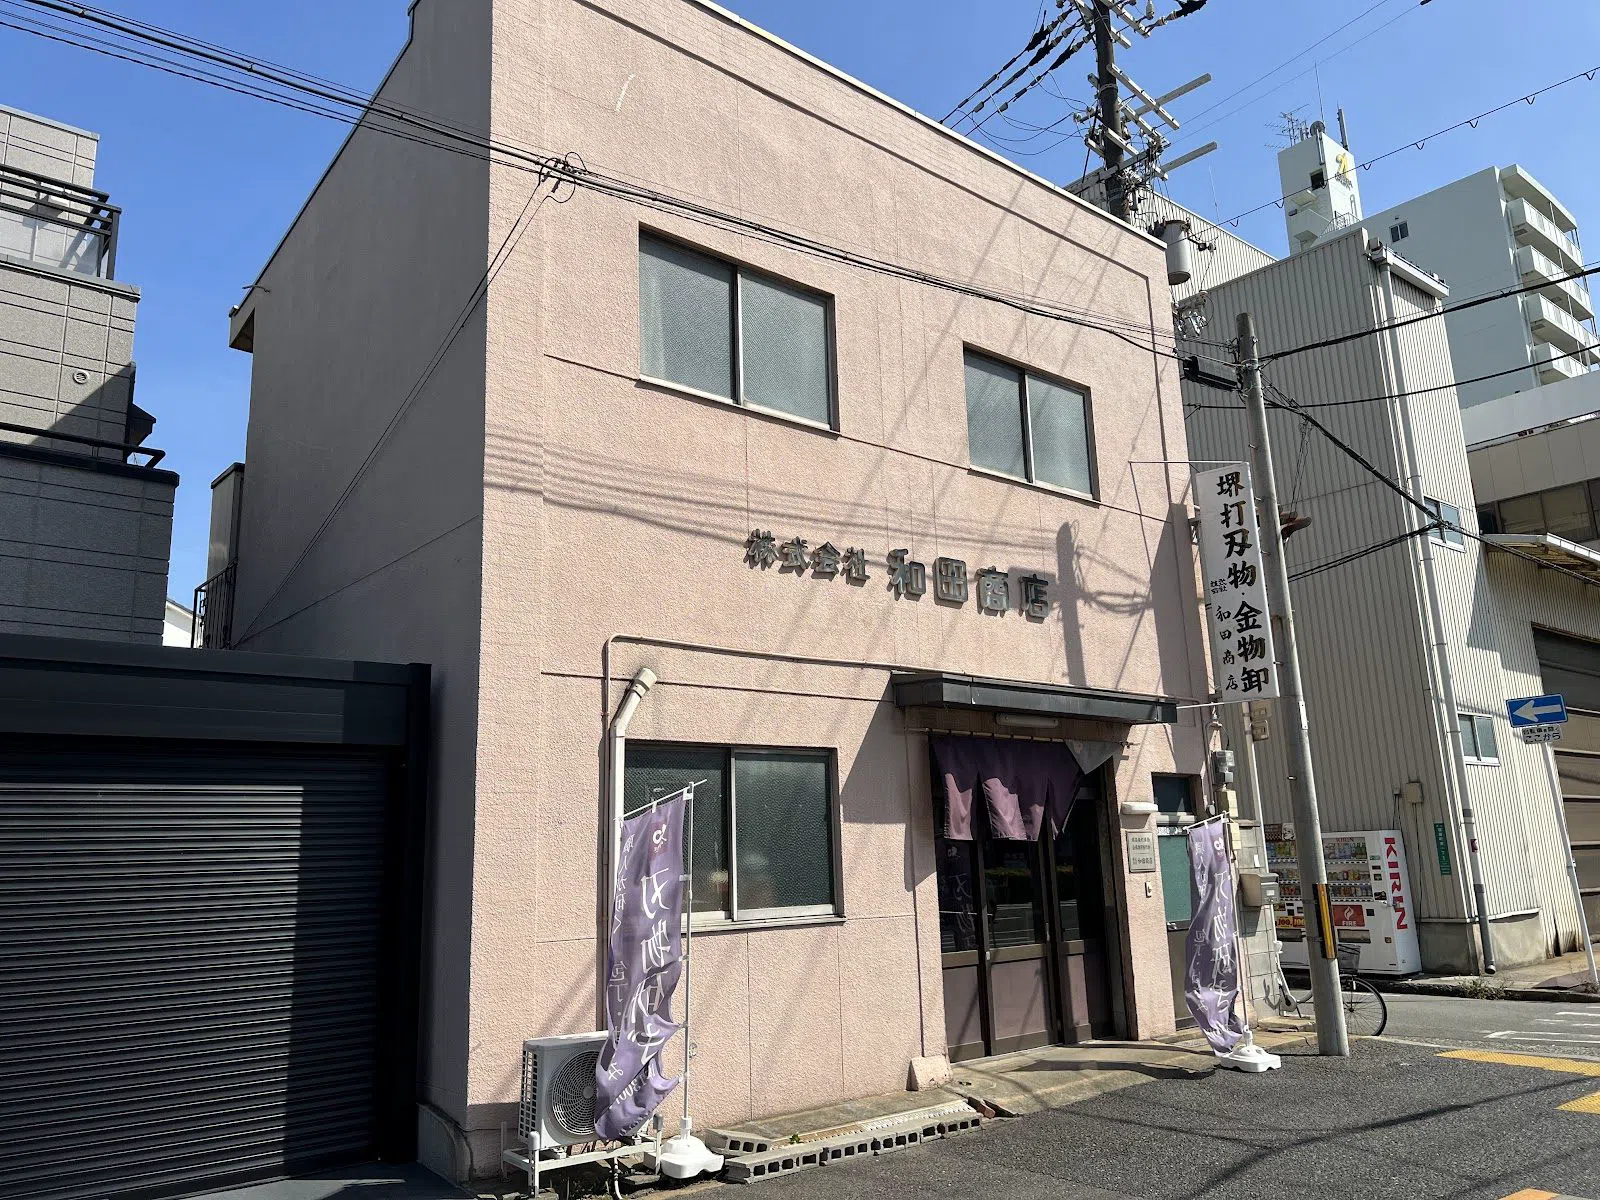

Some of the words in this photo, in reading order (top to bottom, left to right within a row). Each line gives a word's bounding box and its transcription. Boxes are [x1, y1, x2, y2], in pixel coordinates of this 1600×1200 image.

[744, 528, 870, 586] 株式会社
[887, 548, 1049, 622] 和田商店
[1216, 605, 1238, 691] 和田商店
[1525, 732, 1561, 743] ここから
[1384, 837, 1408, 930] KIRIN
